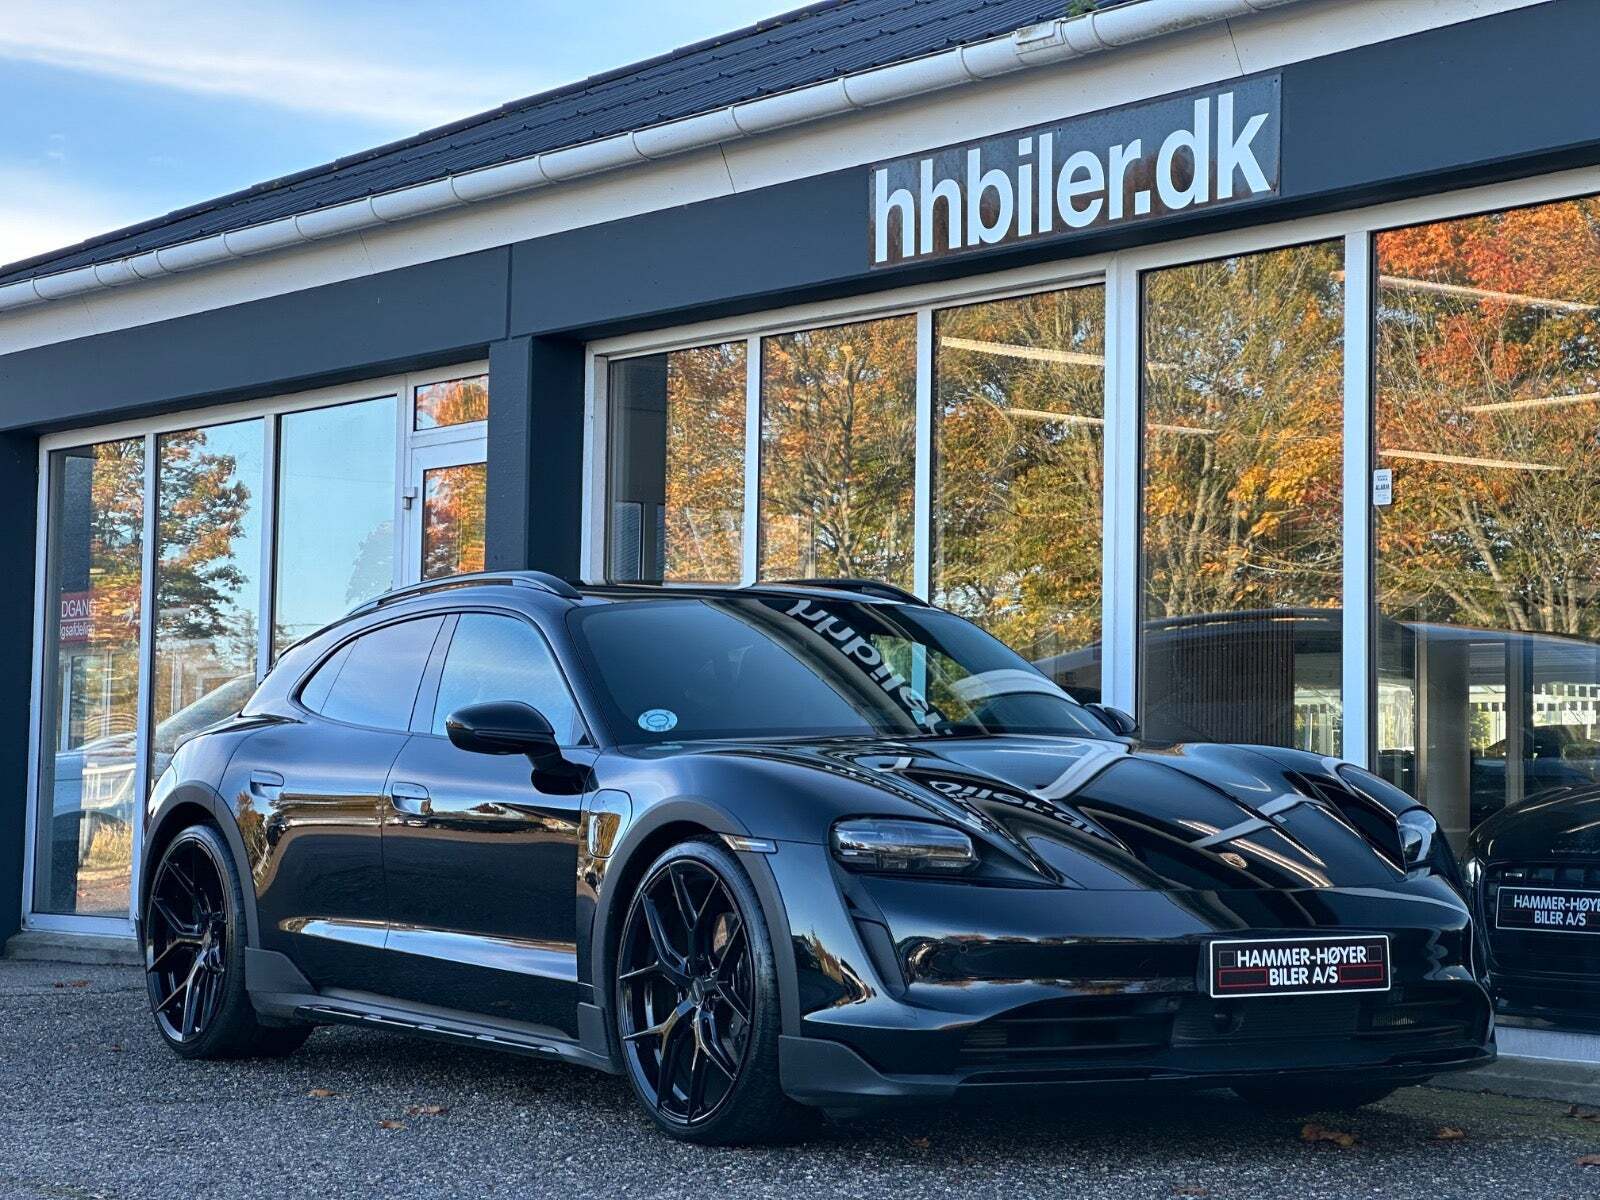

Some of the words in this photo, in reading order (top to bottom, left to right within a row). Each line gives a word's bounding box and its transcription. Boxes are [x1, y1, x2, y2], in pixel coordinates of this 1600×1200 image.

[875, 92, 1271, 263] hhbiler.dk
[1534, 910, 1563, 925] BILER
[1565, 912, 1586, 926] A/S
[1237, 946, 1367, 968] HAMMER-HØYER
[1269, 968, 1309, 986] BILER
[1312, 966, 1339, 984] A/S
